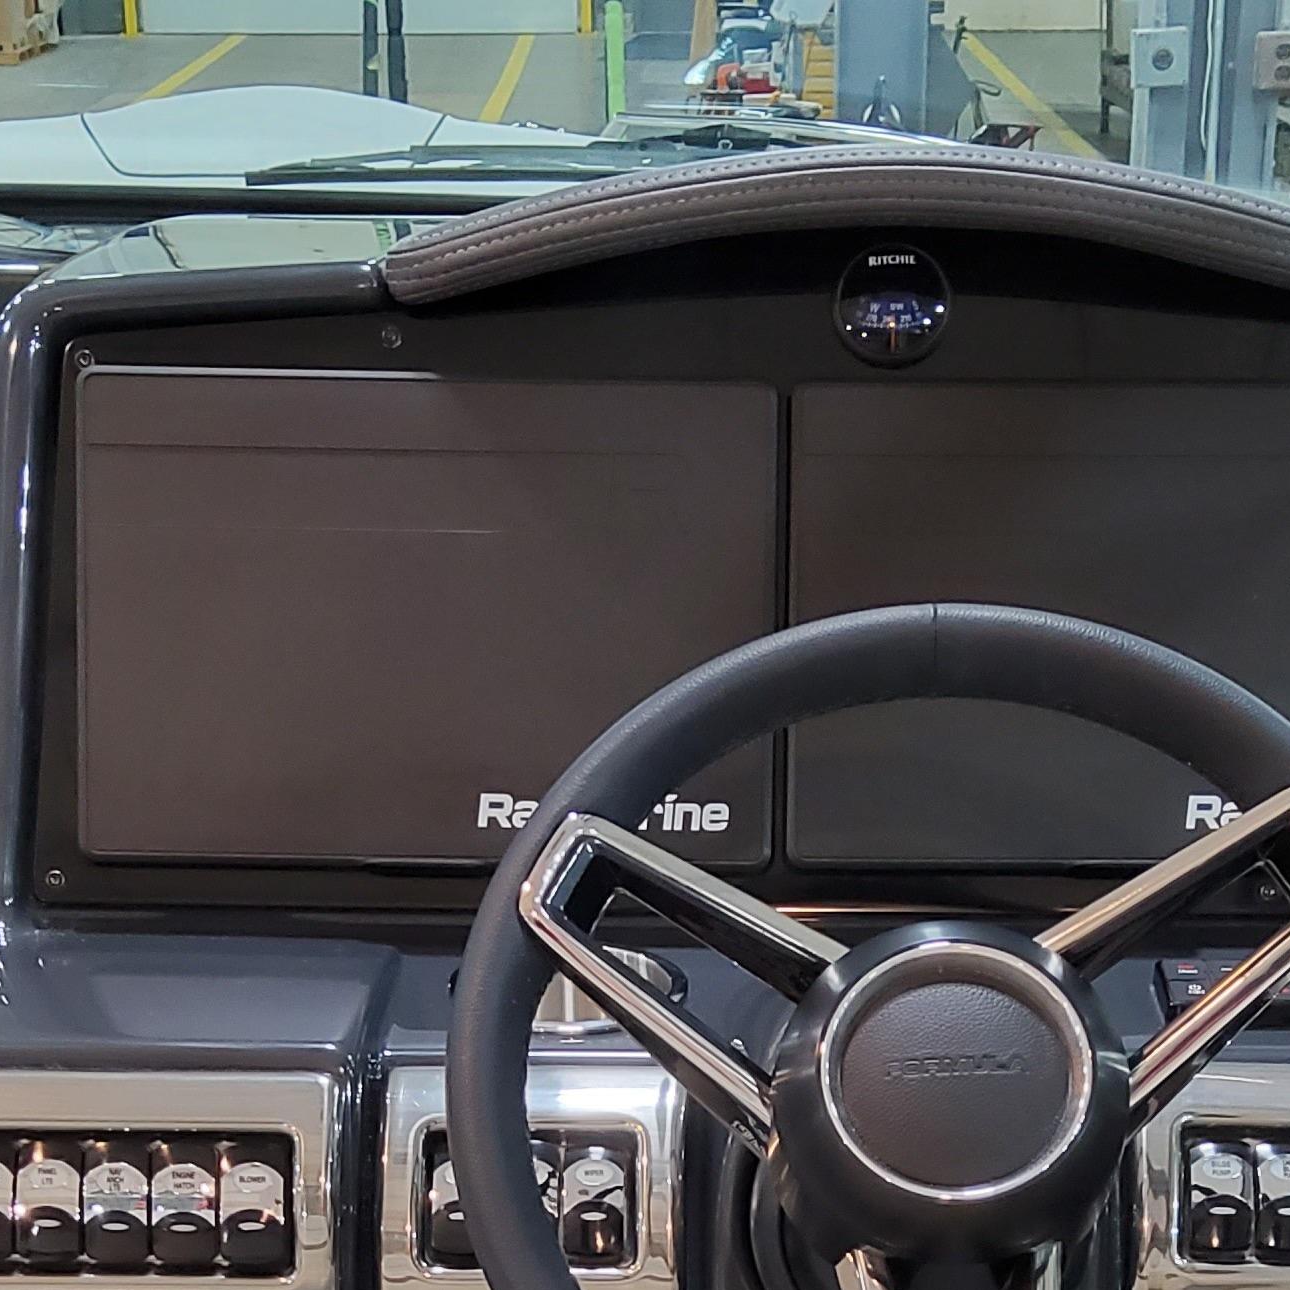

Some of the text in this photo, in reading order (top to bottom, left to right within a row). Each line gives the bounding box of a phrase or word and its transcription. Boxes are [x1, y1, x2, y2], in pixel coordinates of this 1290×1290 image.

[868, 255, 916, 267] RITCHIE
[477, 793, 730, 832] Rarine
[884, 1054, 1030, 1080] FORMULA
[172, 1171, 196, 1179] ENGINE
[239, 1175, 266, 1183] BLOWER
